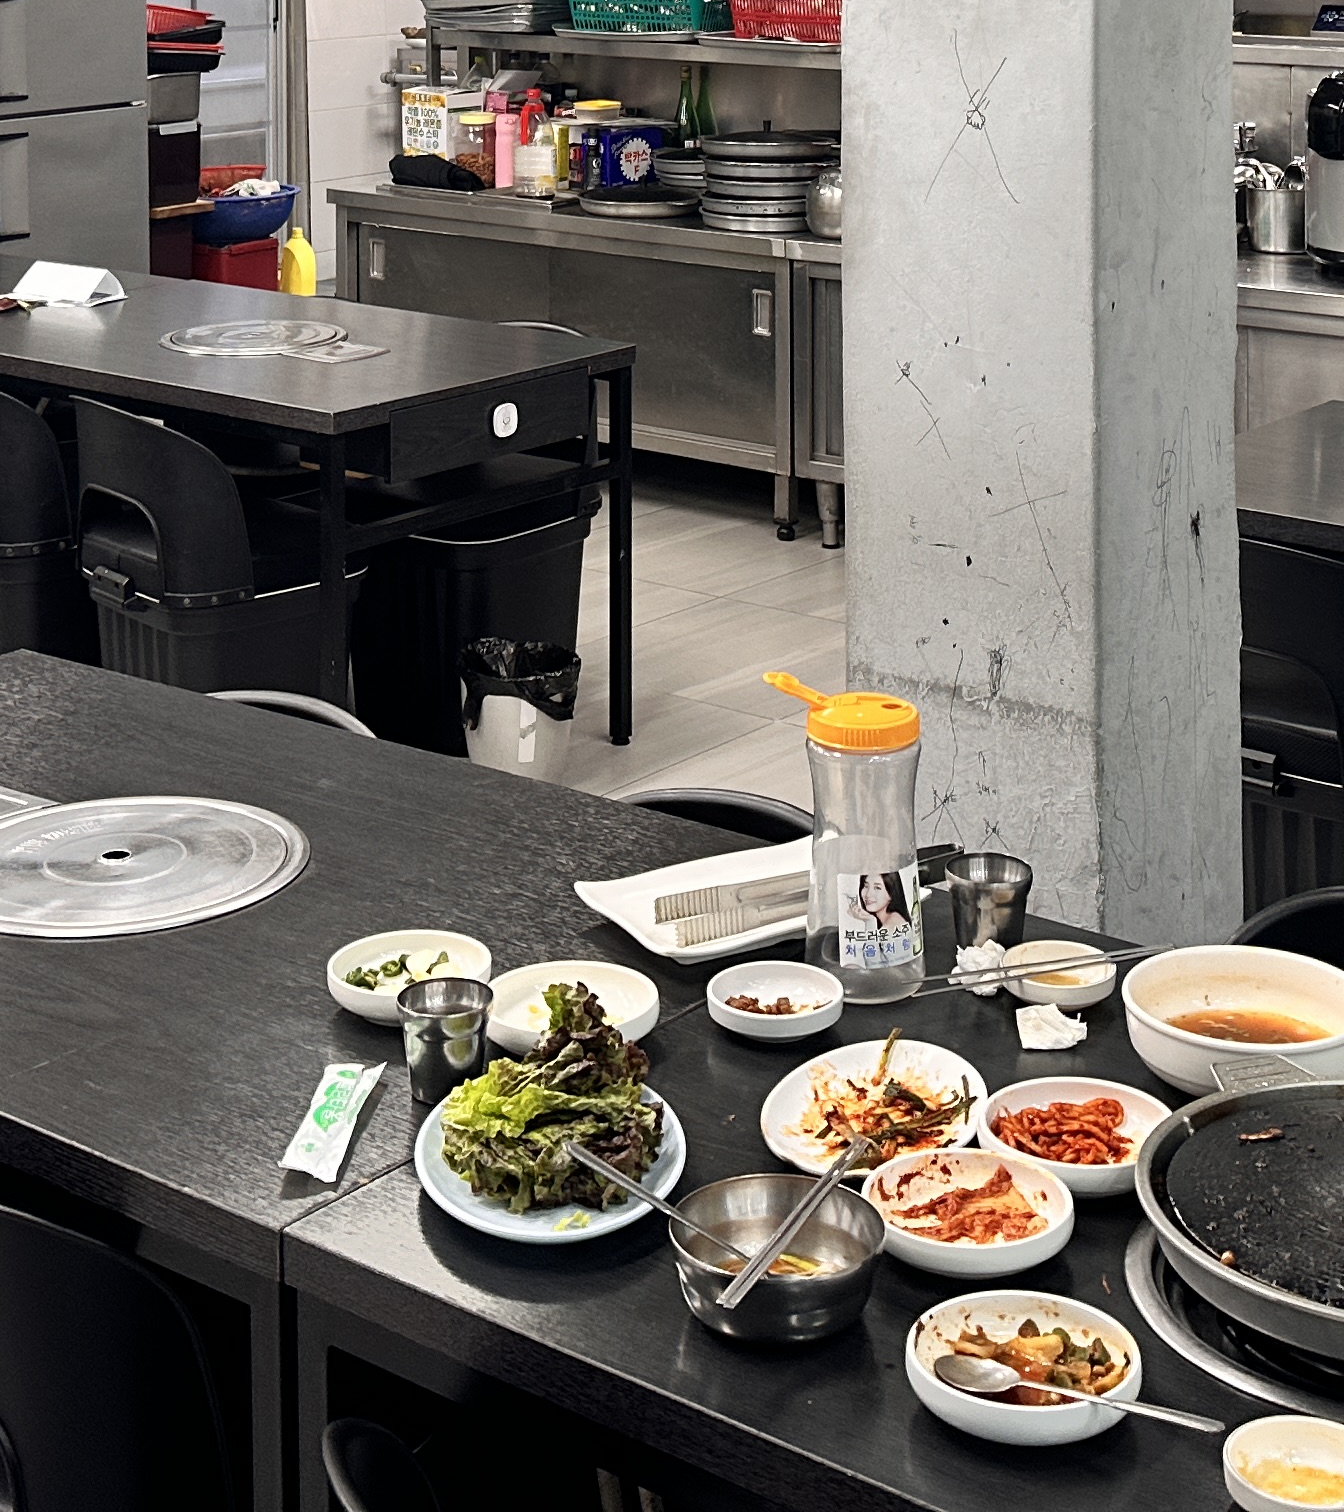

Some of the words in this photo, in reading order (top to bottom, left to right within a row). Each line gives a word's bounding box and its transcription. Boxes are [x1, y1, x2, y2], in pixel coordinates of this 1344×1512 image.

[624, 149, 649, 164] 박카스
[634, 164, 640, 176] F
[844, 929, 889, 943] 부드러운
[892, 923, 910, 938] 소주
